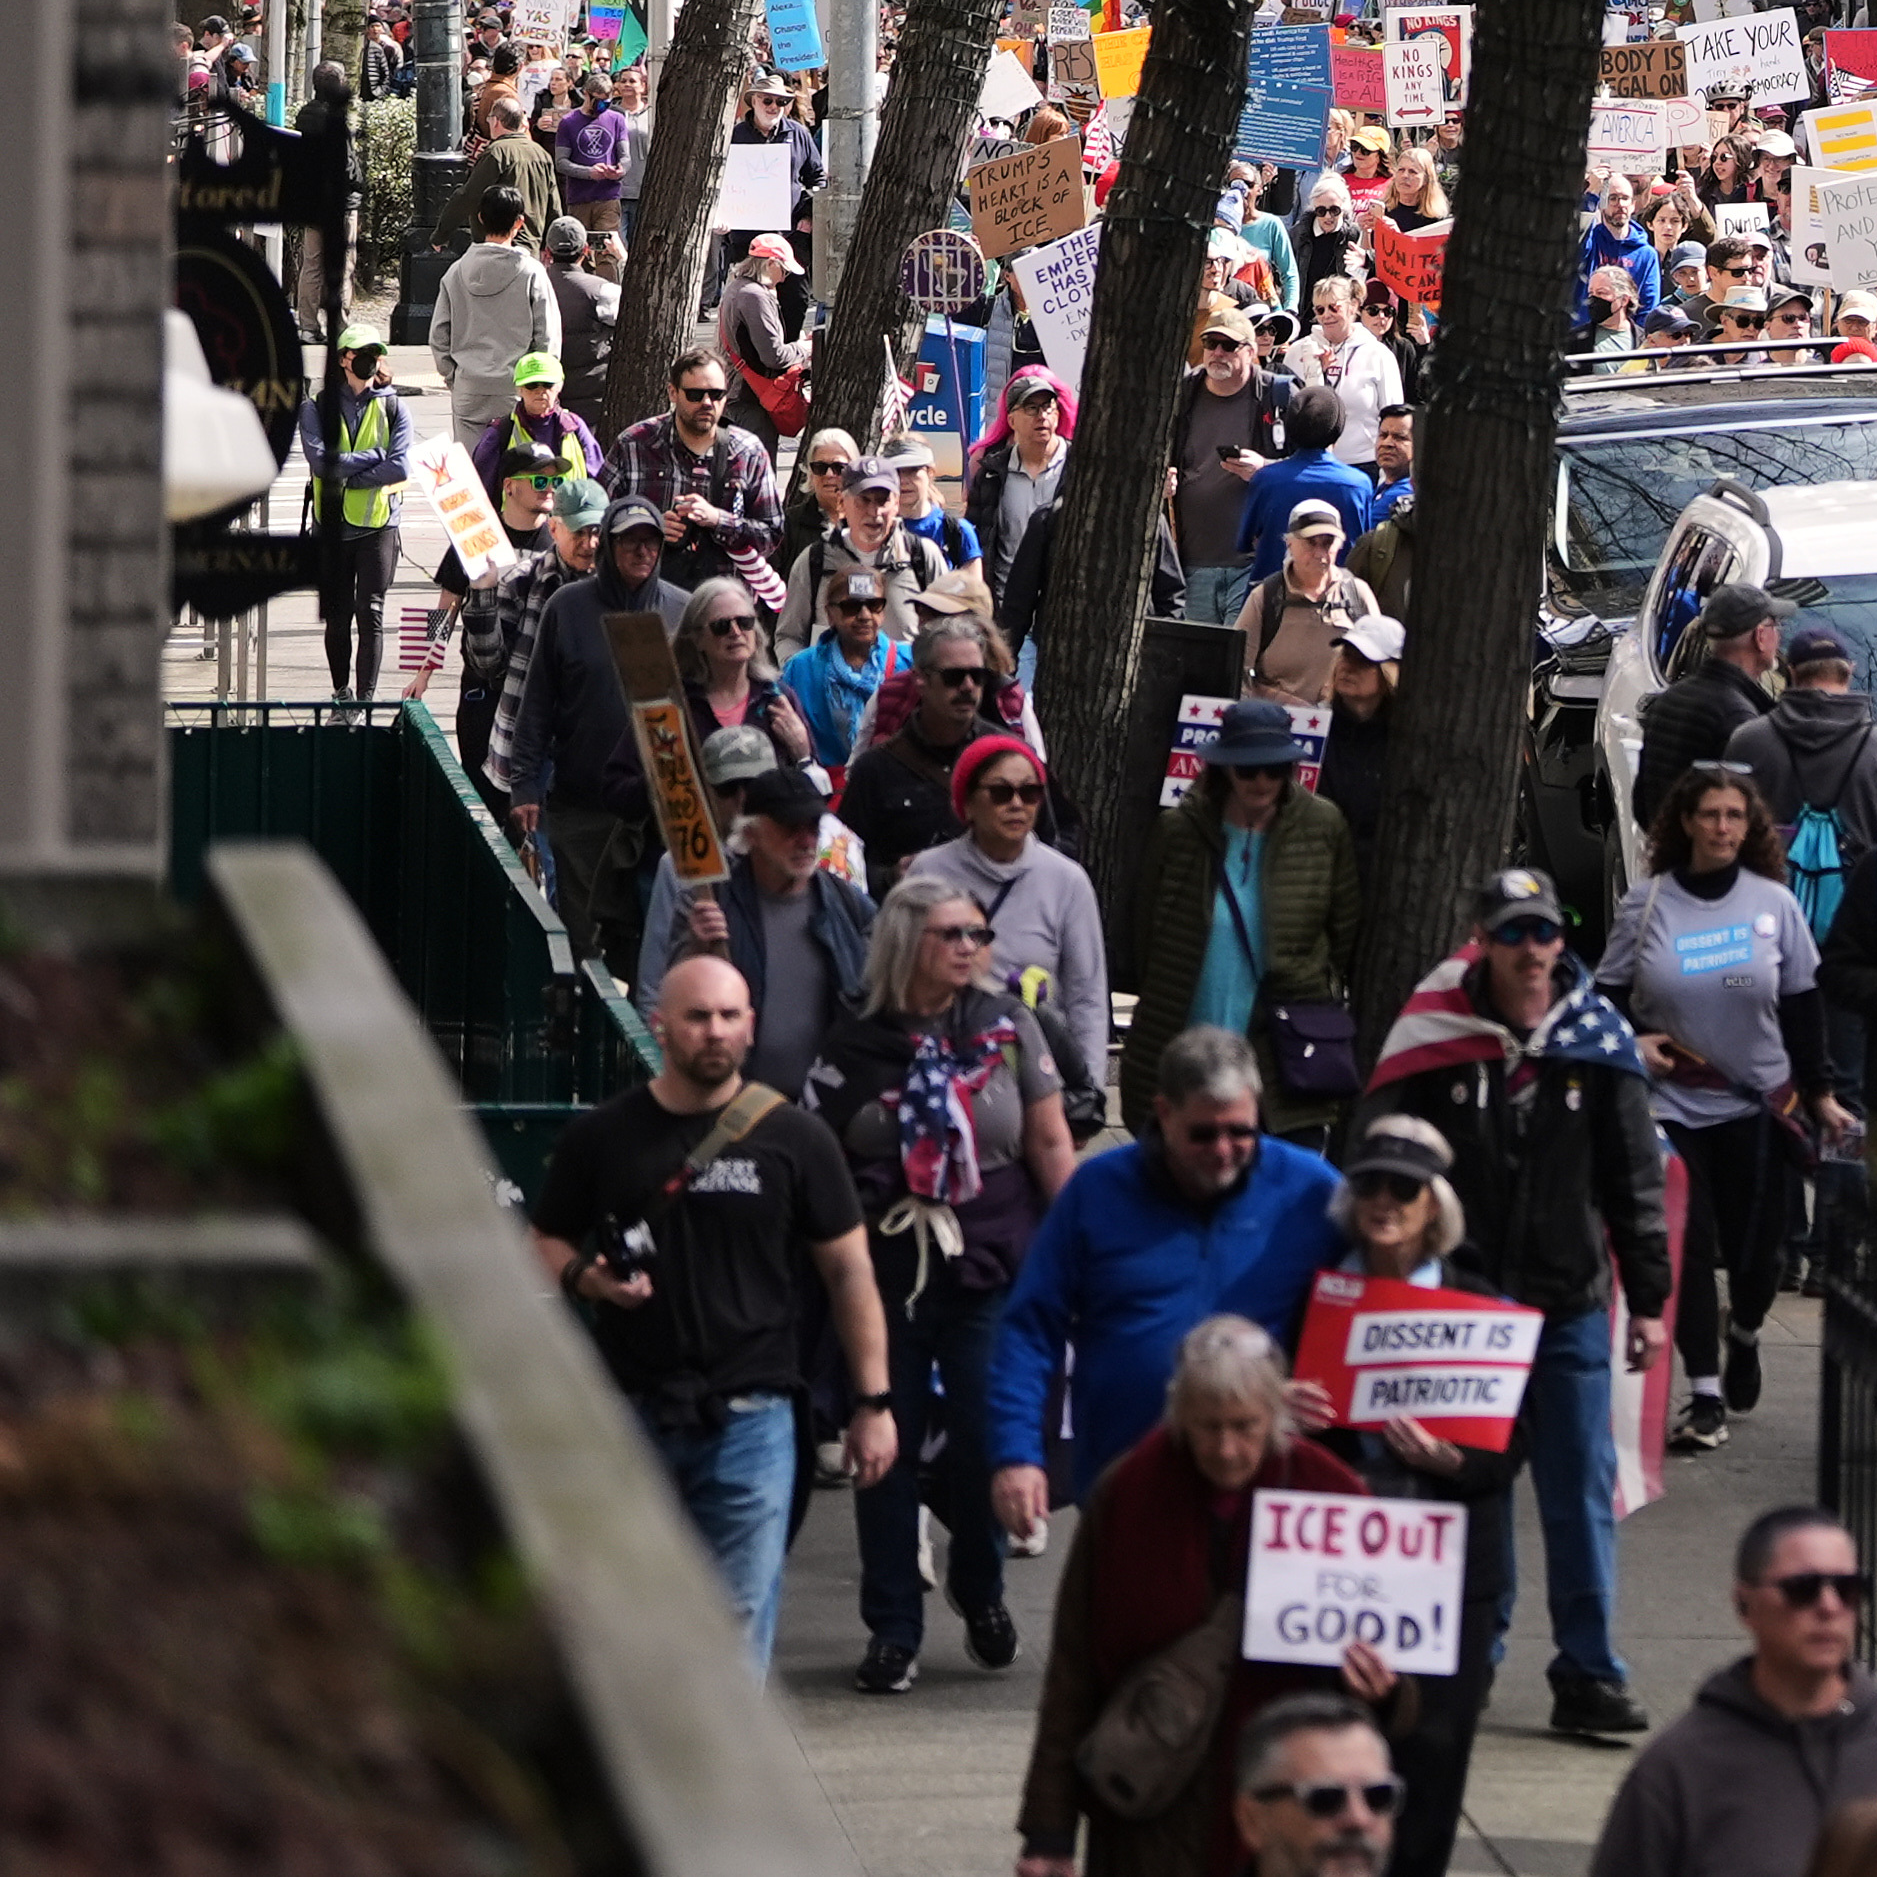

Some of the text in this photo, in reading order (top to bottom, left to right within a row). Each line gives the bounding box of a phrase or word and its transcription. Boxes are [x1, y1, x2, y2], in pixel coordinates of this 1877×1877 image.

[773, 23, 807, 36] Change
[1406, 15, 1457, 29] NO KINGS
[1685, 20, 1791, 63] TAKE YOUR
[779, 51, 820, 64] President
[1402, 49, 1420, 62] NO
[1392, 64, 1433, 79] KINGS
[1404, 93, 1425, 103] TIME
[1405, 81, 1422, 91] ANY
[1601, 115, 1654, 144] AMERICA
[972, 150, 1051, 188] TRUMP'S
[977, 171, 1070, 211] HEART A
[994, 188, 1071, 227] BLOCK OF
[1057, 228, 1094, 256] THE
[1837, 221, 1874, 243] AND
[1052, 270, 1088, 295] HAS
[1405, 273, 1441, 289] CAN
[1859, 270, 1877, 281] NO
[1417, 287, 1442, 303] ICE
[1364, 1323, 1515, 1351] DISSENT IS
[1370, 1377, 1500, 1409] PATRIOTIC
[1266, 1503, 1346, 1556] ICE
[1317, 1573, 1386, 1602] FOR
[1278, 1604, 1443, 1650] GOOD!
